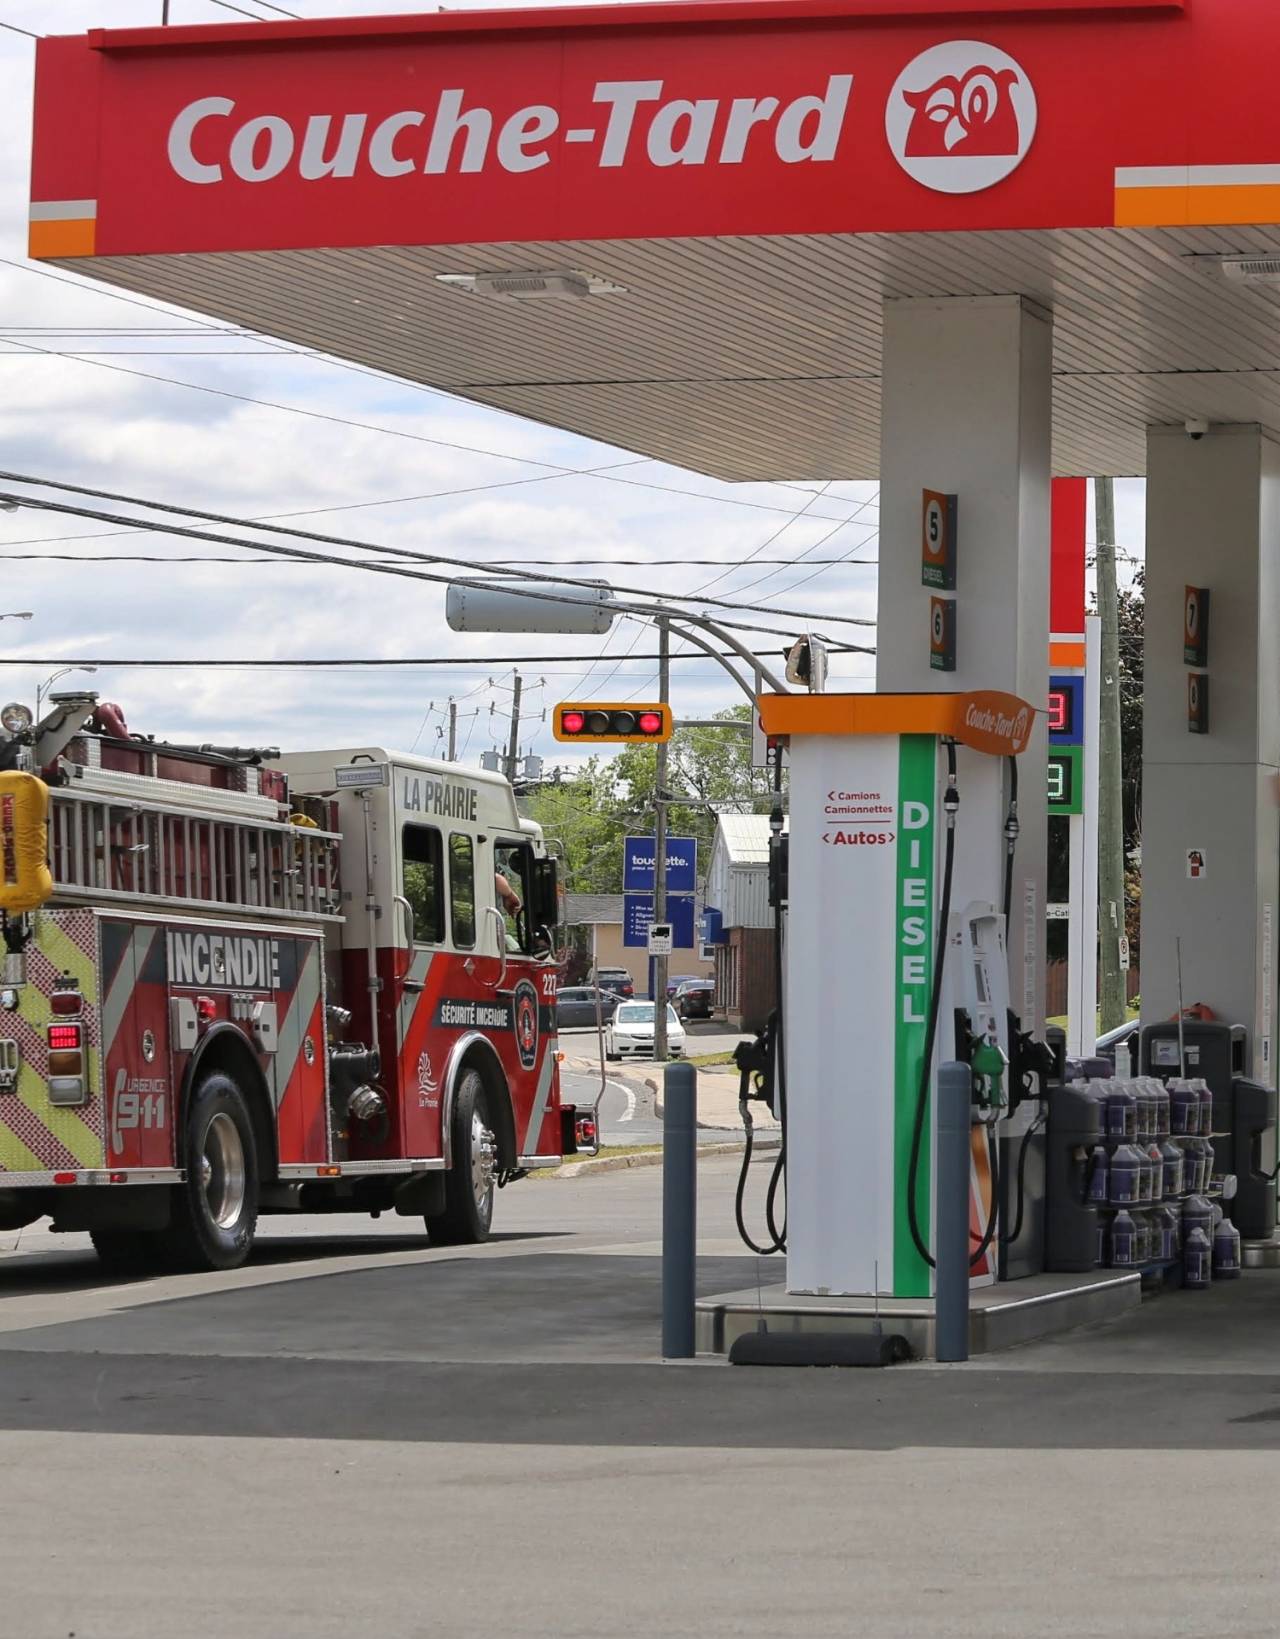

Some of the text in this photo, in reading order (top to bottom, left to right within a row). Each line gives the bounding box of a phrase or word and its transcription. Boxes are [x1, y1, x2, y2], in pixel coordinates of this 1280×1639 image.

[167, 74, 854, 184] Couche-Tard
[930, 512, 938, 542] 5
[935, 613, 941, 636] 6
[1189, 604, 1195, 627] 7
[966, 703, 1016, 738] Couche-Tard
[404, 776, 478, 822] LA PRAIRIE
[838, 792, 881, 801] Camions
[824, 804, 893, 814] Camionnettes
[833, 831, 887, 845] Autos
[631, 855, 689, 867] toucette.
[902, 801, 930, 1023] DIESEL
[166, 931, 281, 989] INCENDIE
[543, 973, 557, 996] 227
[441, 1000, 508, 1027] SÉCURITÉ INCENDIE
[127, 1078, 166, 1093] URGENCE
